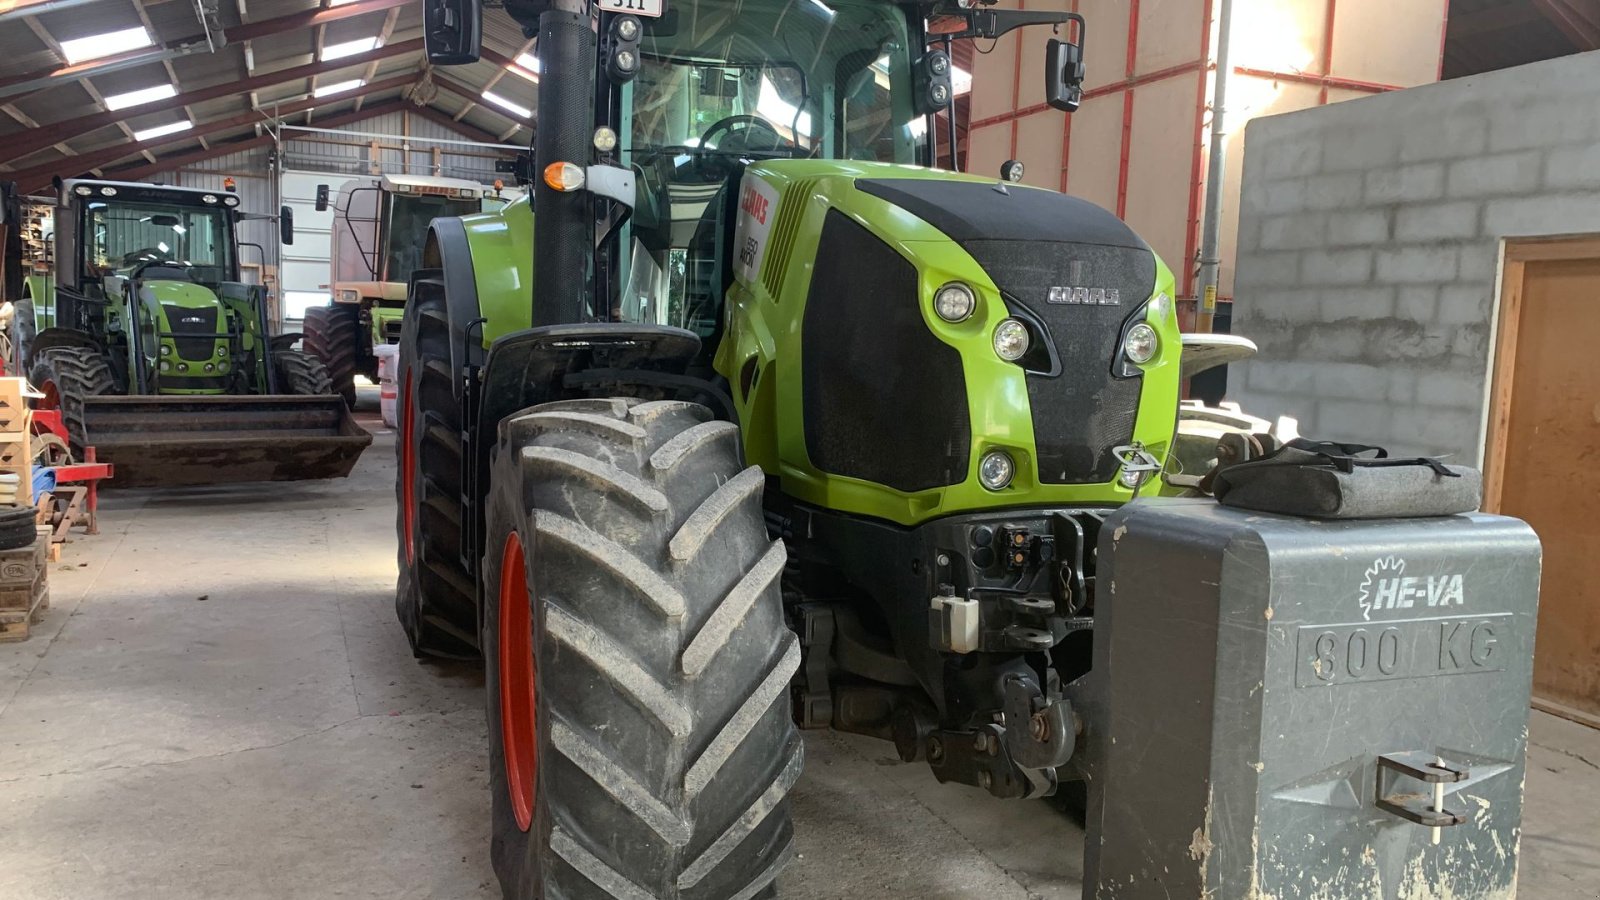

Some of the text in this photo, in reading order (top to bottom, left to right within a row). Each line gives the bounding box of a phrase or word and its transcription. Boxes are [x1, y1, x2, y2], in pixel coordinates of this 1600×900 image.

[414, 185, 459, 195] CLAAS
[741, 185, 769, 225] CLAAS
[1048, 286, 1121, 306] CLAAS
[1373, 574, 1465, 611] HE-VA
[1313, 620, 1499, 681] 800 KG
